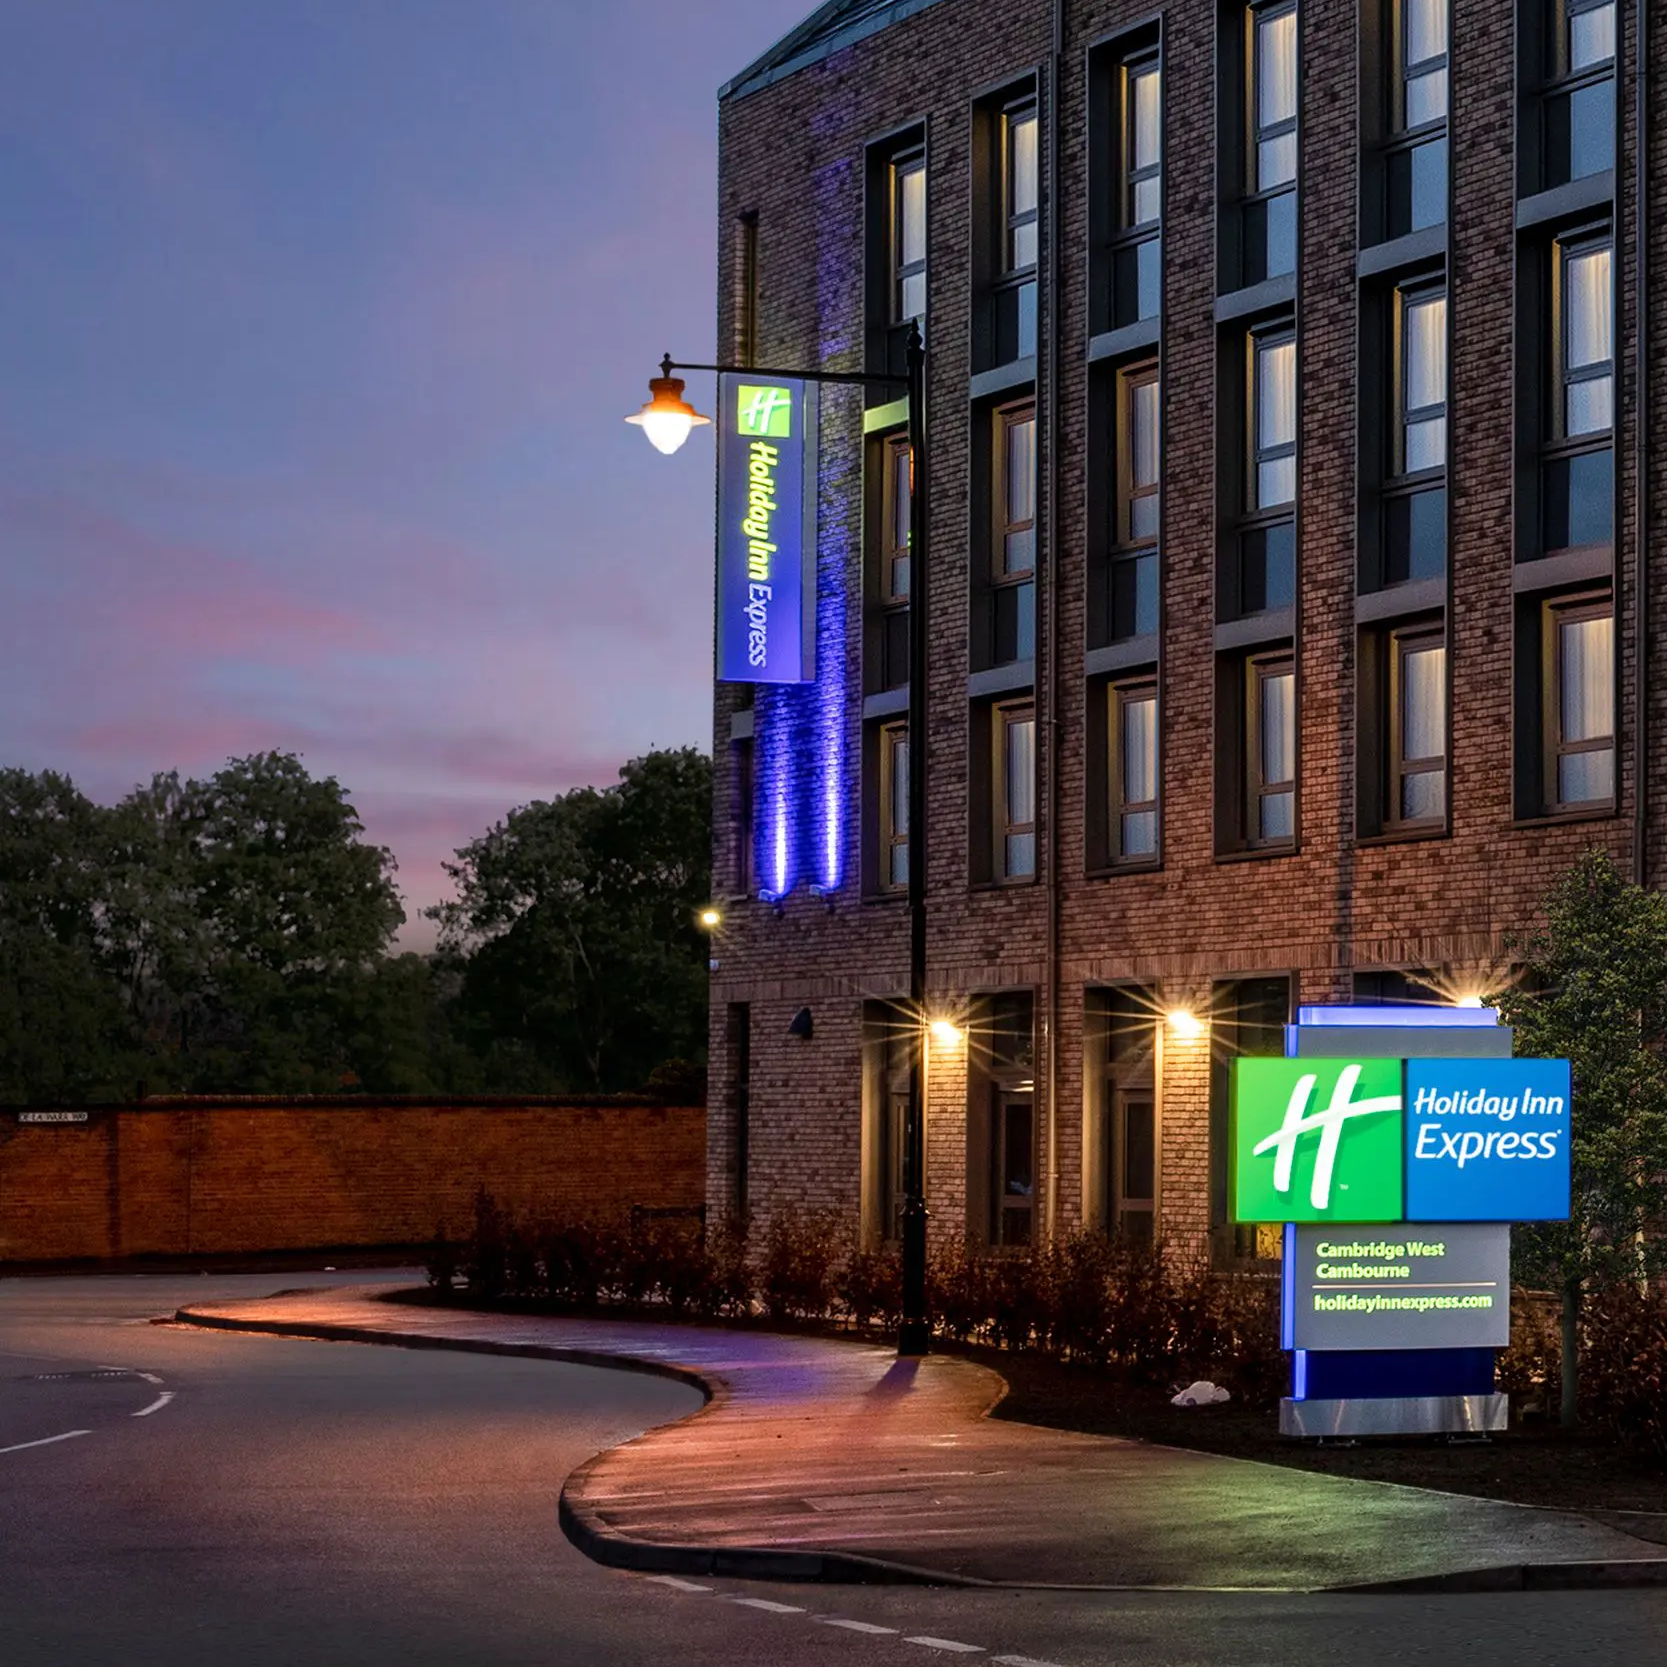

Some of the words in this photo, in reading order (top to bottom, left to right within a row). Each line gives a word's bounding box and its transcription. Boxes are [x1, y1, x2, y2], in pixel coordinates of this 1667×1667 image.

[742, 441, 778, 540] Holiday
[749, 539, 777, 581] Inn
[743, 583, 772, 668] Express
[1413, 1087, 1518, 1121] Holiday
[1520, 1087, 1564, 1115] Inn
[1414, 1123, 1558, 1169] Express
[1316, 1241, 1405, 1260] Cambridge
[1406, 1241, 1445, 1256] West
[1316, 1263, 1410, 1278] Cambourne
[1314, 1294, 1493, 1313] holidayinnexpress.com
